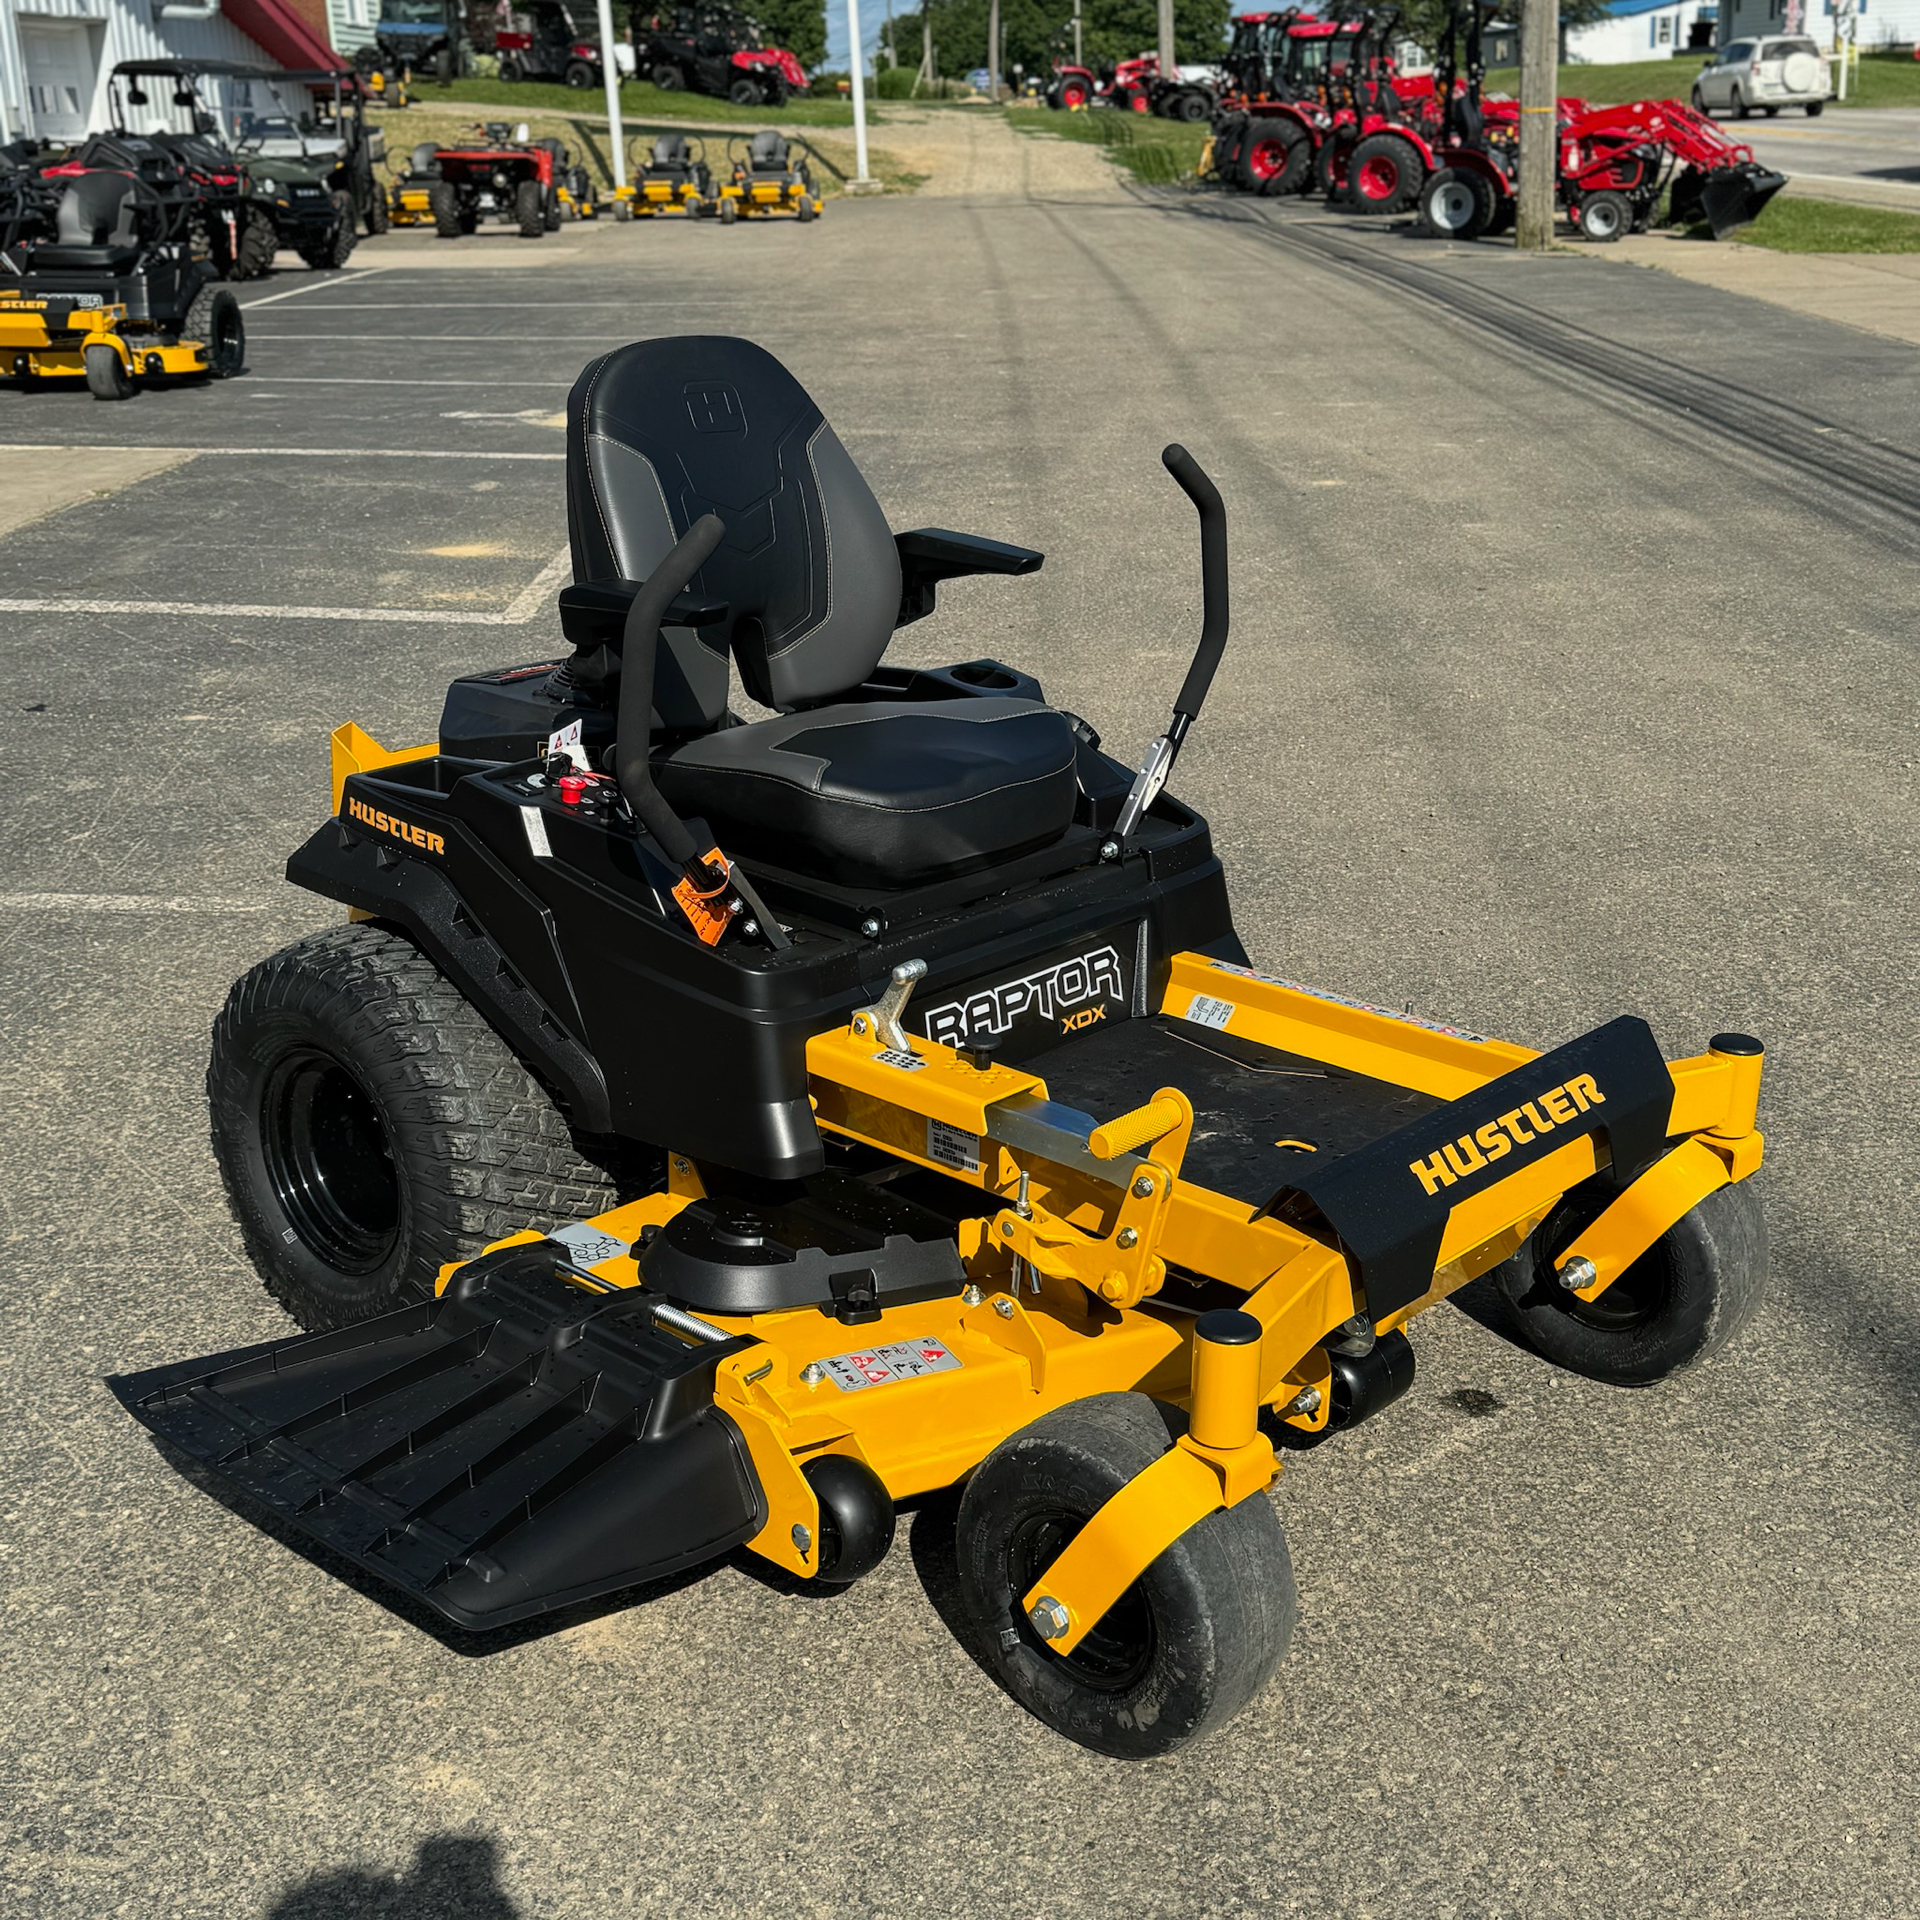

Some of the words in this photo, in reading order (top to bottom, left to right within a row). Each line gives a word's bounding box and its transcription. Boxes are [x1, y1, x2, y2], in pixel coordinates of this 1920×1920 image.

[0, 300, 48, 310] STLER
[348, 796, 446, 856] HUSTLER
[925, 945, 1124, 1049] RAPTOR
[1060, 1003, 1108, 1035] XDX
[1408, 1072, 1607, 1197] HUSTLER
